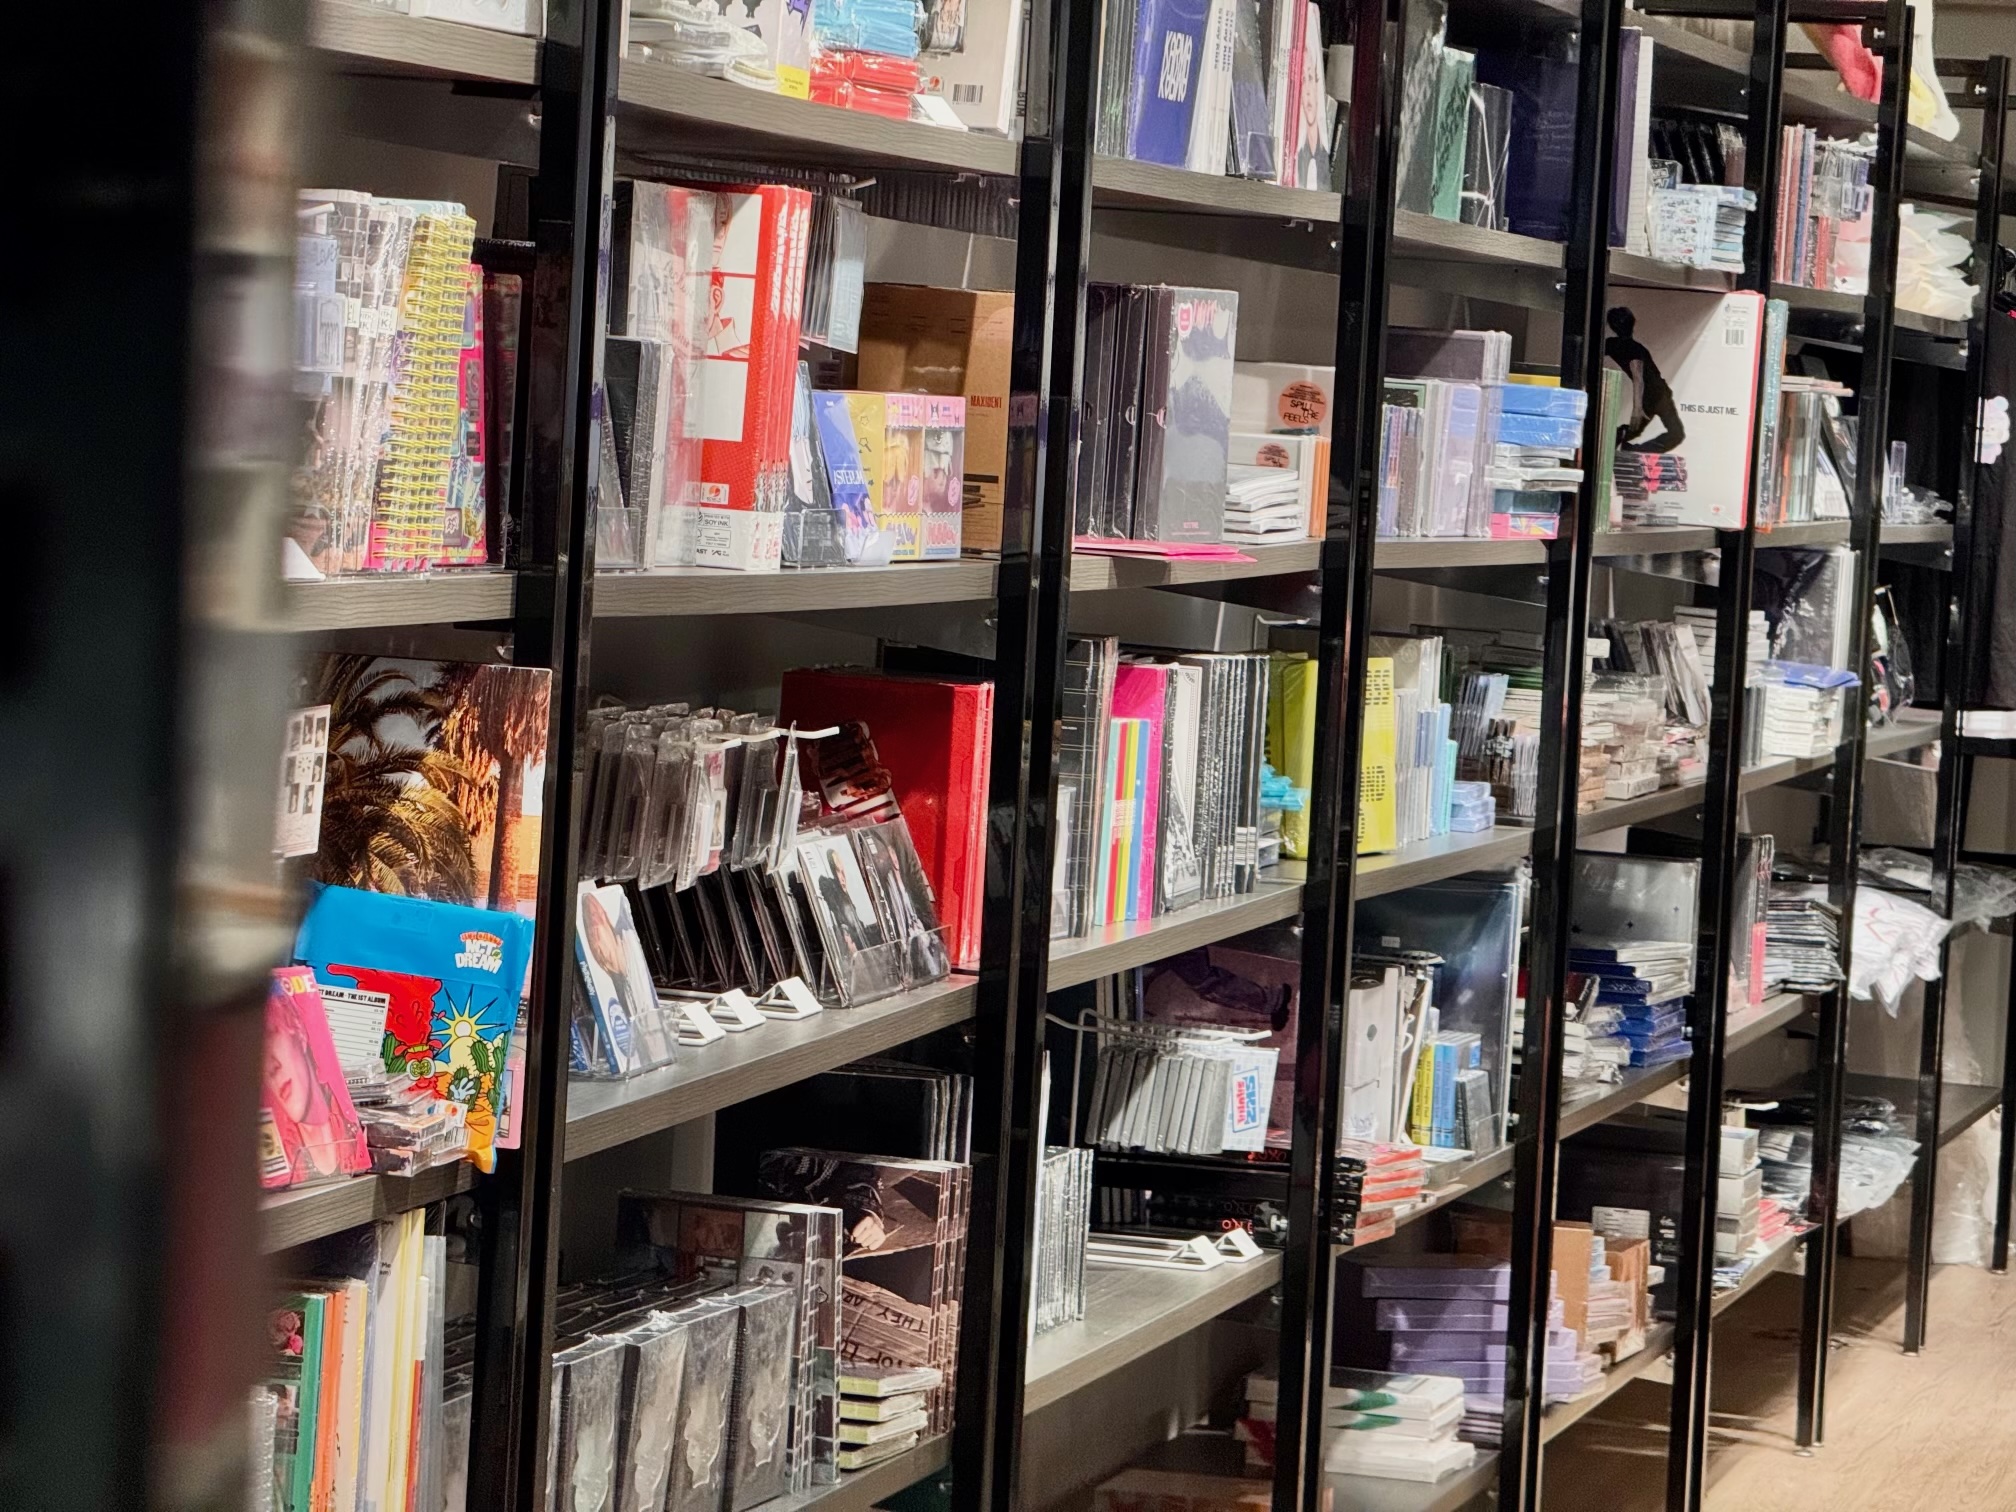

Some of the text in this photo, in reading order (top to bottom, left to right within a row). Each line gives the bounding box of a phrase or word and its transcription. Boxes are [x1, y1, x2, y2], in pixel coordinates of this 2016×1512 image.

[1680, 403, 1697, 413] THIS
[1697, 404, 1706, 413] IS
[1705, 405, 1724, 415] JUST
[465, 939, 498, 957] NCT
[454, 951, 503, 975] DREAM
[876, 1306, 928, 1334] THEY
